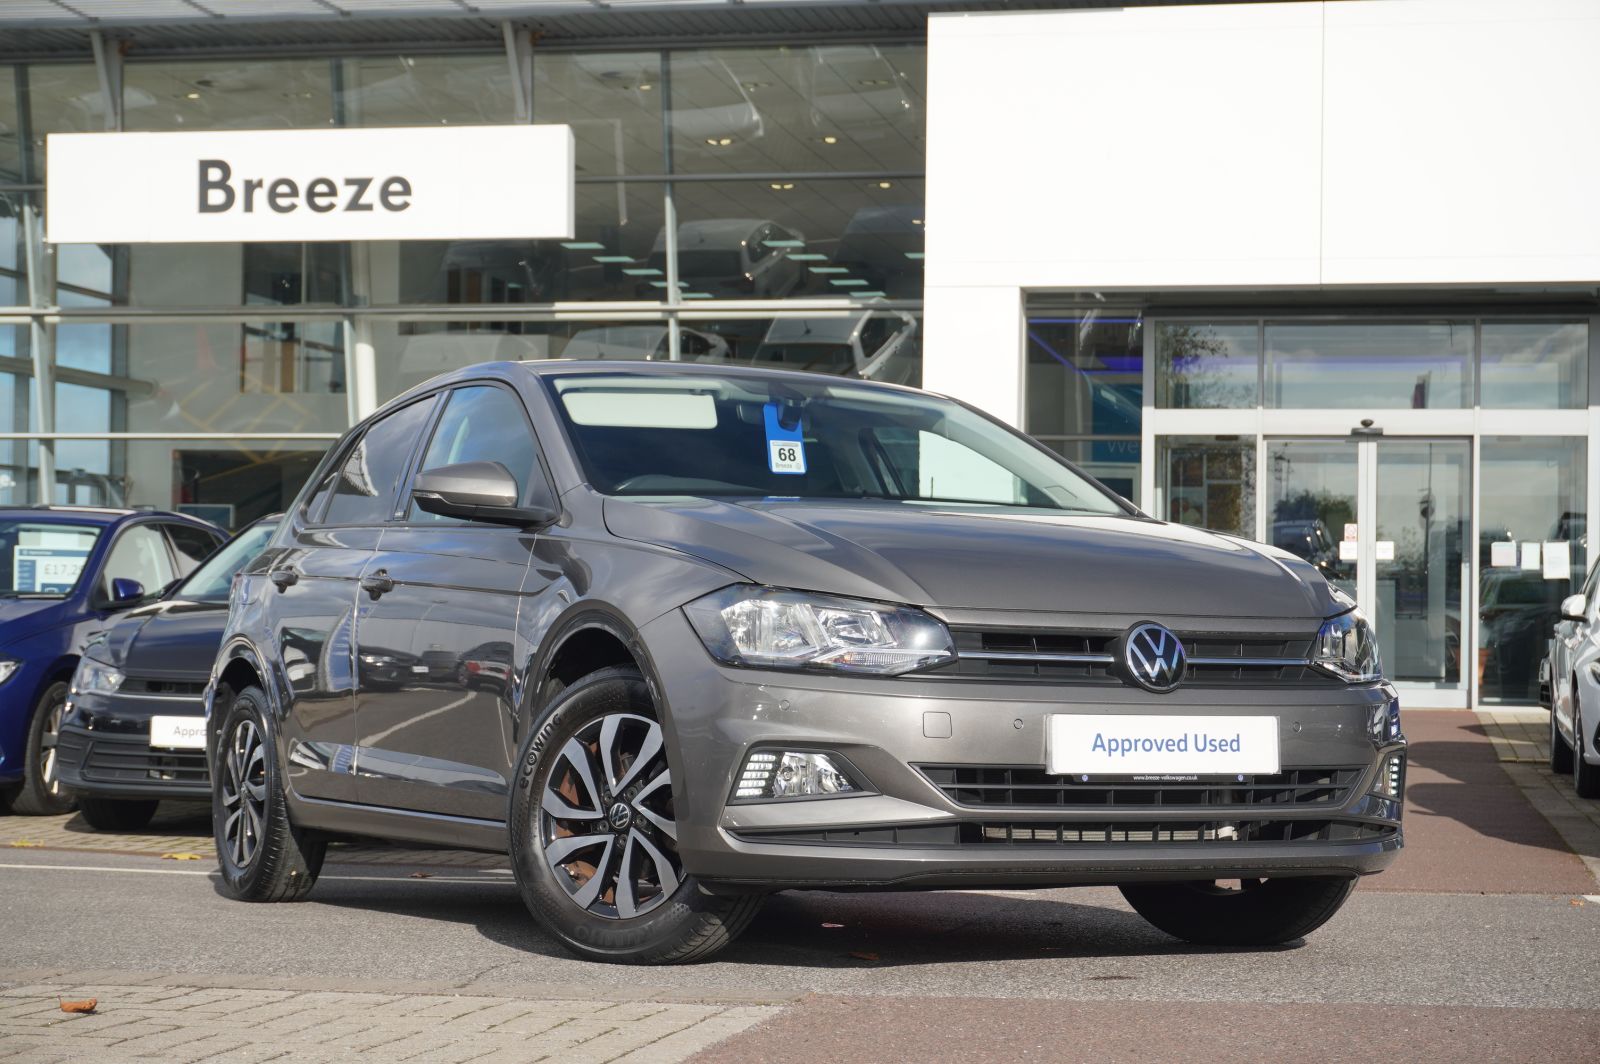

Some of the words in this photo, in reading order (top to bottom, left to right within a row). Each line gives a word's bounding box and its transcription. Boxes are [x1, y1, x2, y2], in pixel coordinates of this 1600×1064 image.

[198, 159, 412, 213] Breeze
[778, 447, 797, 462] 68
[1091, 733, 1188, 757] Approved
[1194, 733, 1241, 752] Used
